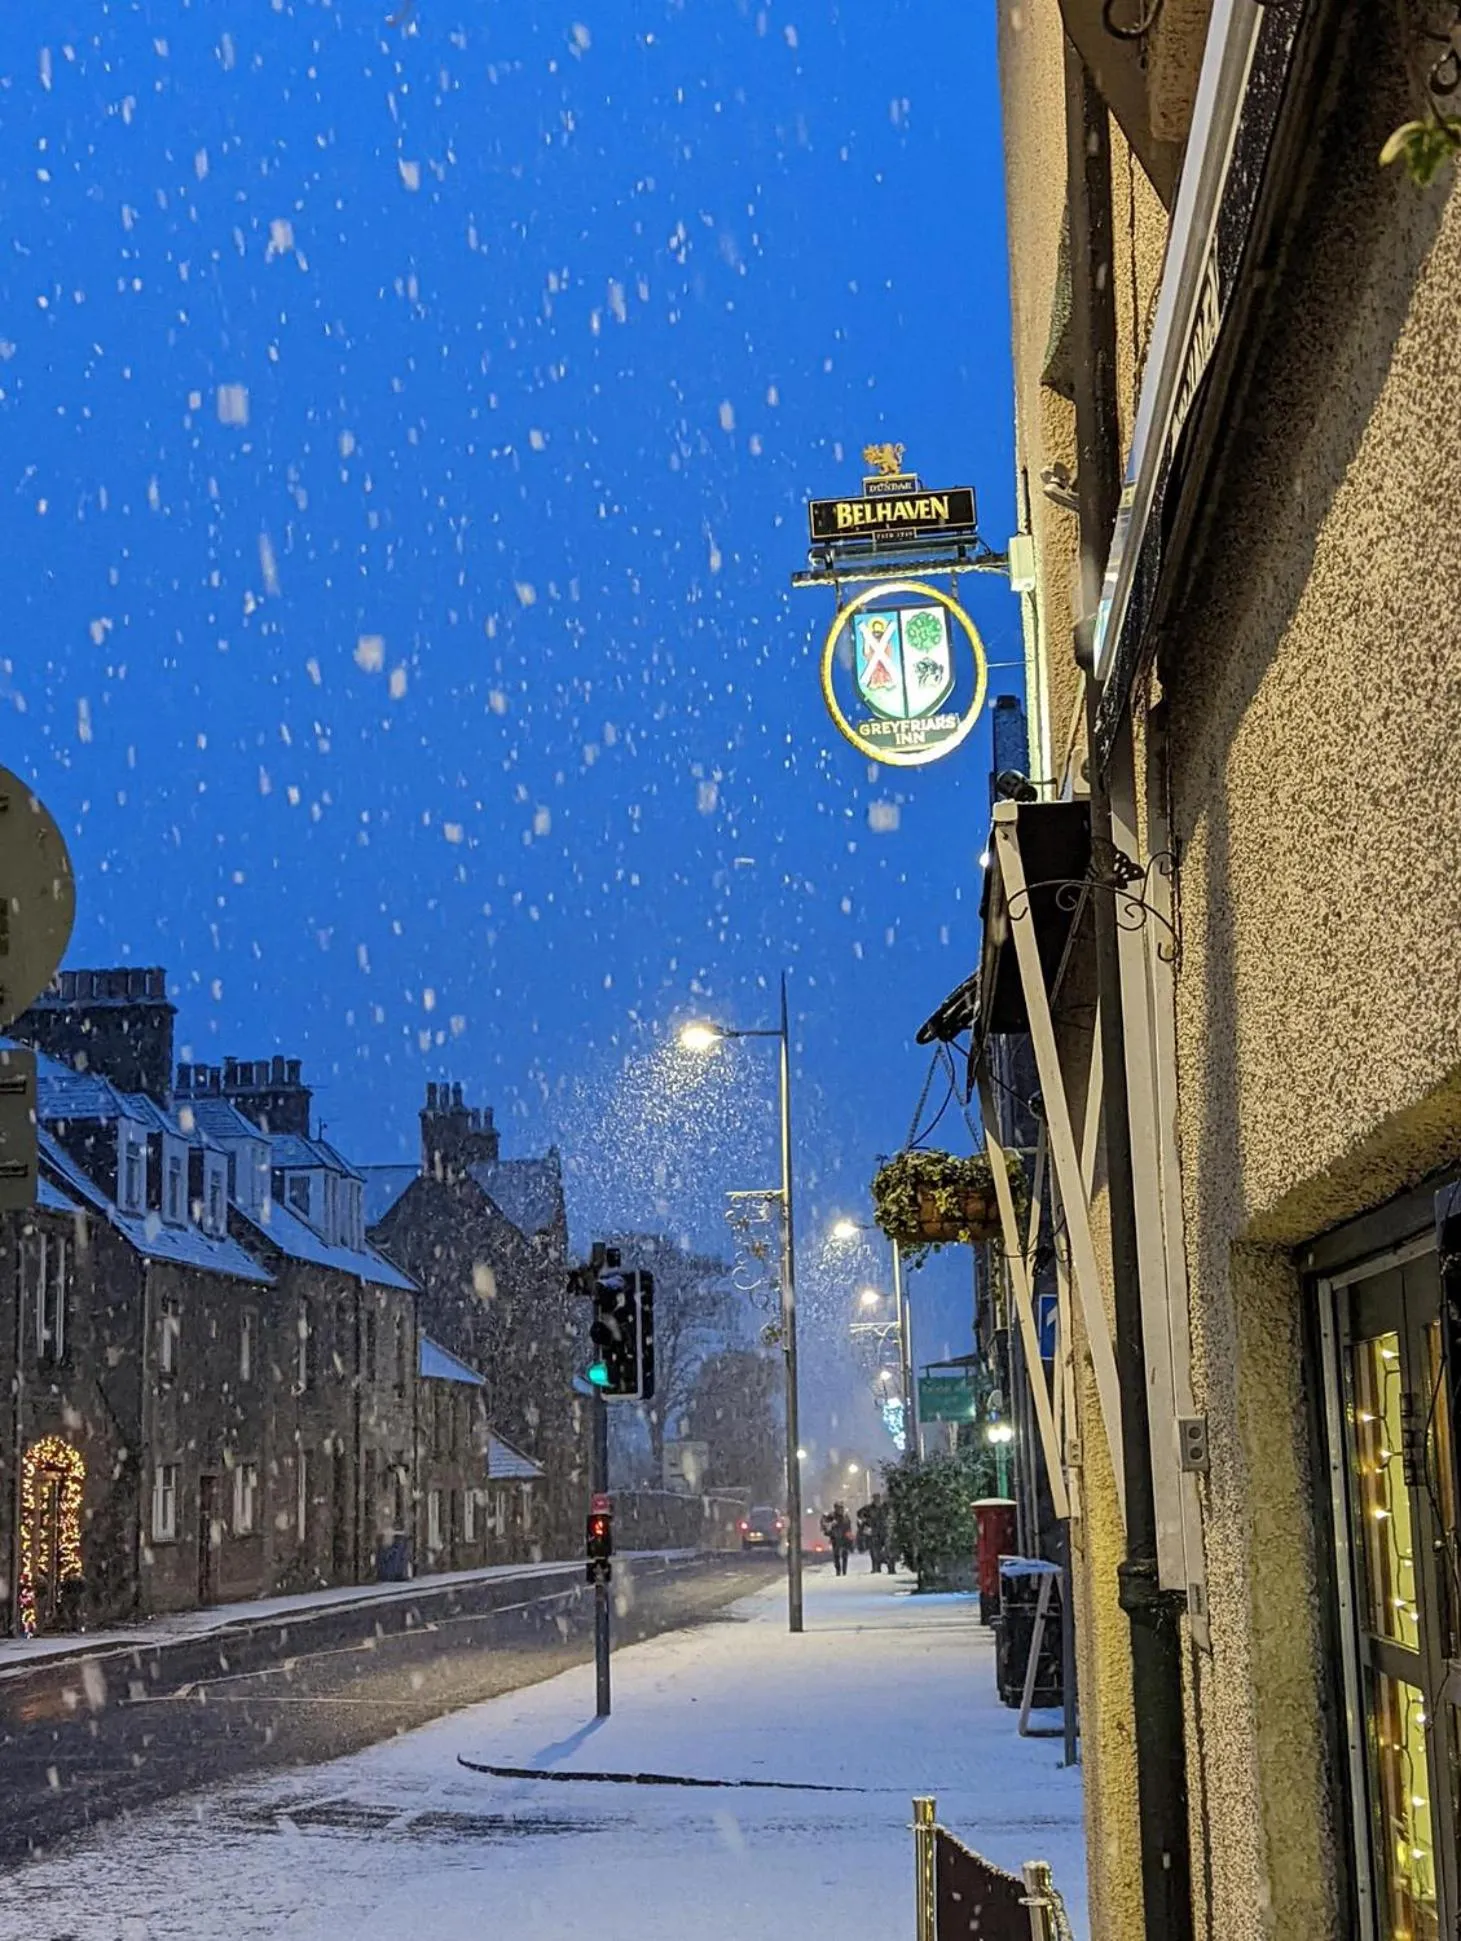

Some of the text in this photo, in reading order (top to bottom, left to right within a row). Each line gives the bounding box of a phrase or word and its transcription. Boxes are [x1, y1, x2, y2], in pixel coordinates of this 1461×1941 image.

[836, 496, 949, 529] BELHAVEN
[859, 714, 957, 735] GREYFRIARS
[895, 731, 925, 745] INN
